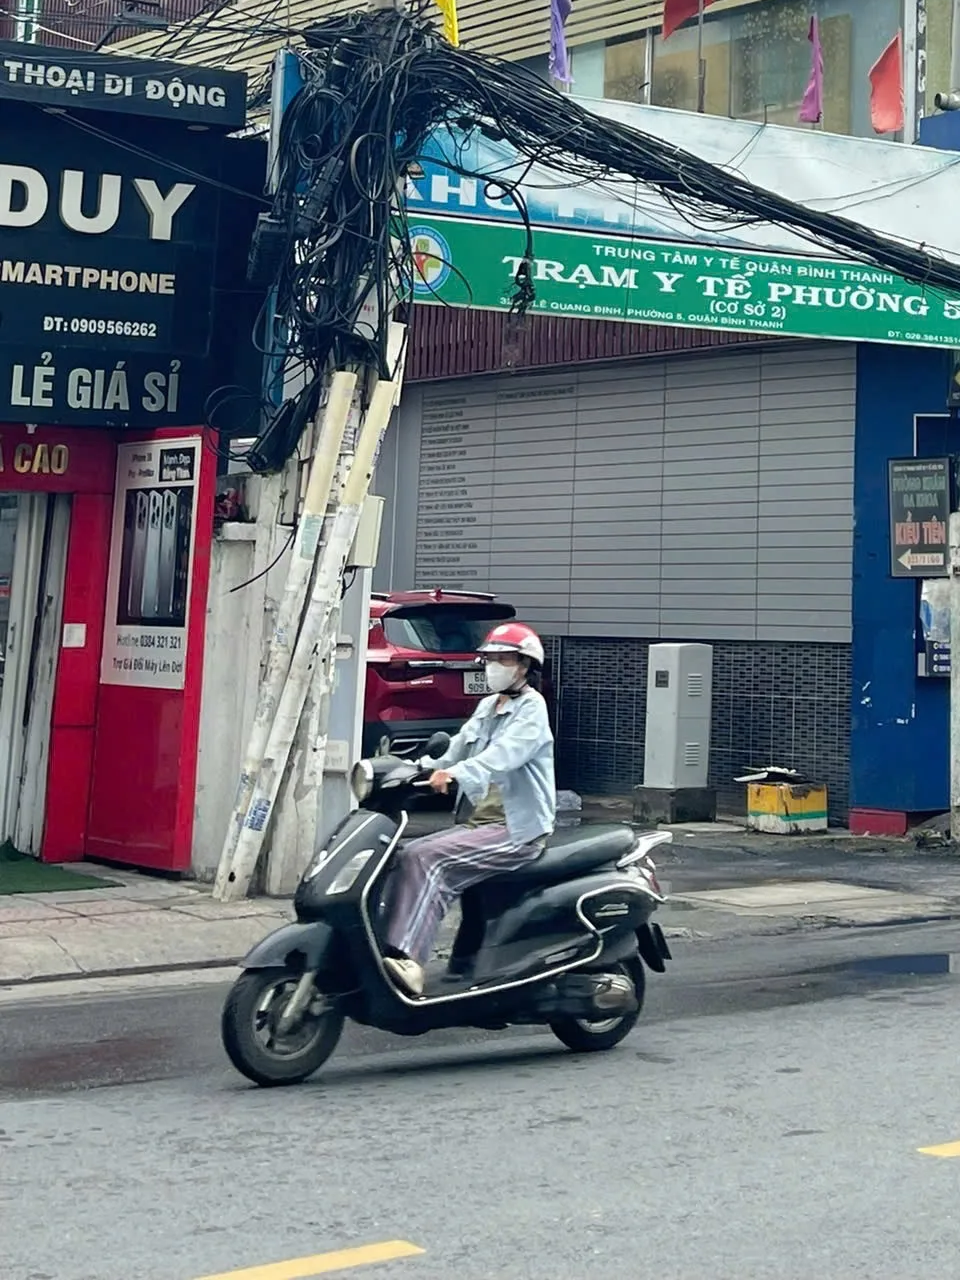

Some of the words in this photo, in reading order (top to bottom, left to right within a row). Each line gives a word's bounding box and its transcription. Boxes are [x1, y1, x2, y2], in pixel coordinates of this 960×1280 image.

[4, 60, 95, 95] THOẠI
[104, 74, 133, 97] DI
[145, 77, 226, 108] ĐỘNG
[0, 164, 196, 241] DUY
[0, 260, 175, 294] MARTPHONE
[592, 245, 655, 261] TRUNG
[661, 251, 697, 265] TÂM
[703, 256, 714, 267] Y
[719, 256, 741, 270] TẾ
[745, 260, 792, 276] QUẬN
[797, 266, 836, 279] BÌNH
[502, 256, 639, 289] TRẠM
[653, 271, 684, 293] Y
[696, 271, 754, 300] TẾ
[767, 281, 930, 316] PHƯỜNG
[551, 302, 591, 313] QUANG
[710, 299, 740, 315] (CƠ
[743, 300, 766, 317] SỞ
[771, 306, 786, 320] 2)
[10, 351, 56, 407] LẺ
[67, 361, 130, 411] GIÁ
[142, 359, 182, 413] SỈ
[14, 443, 69, 474] CAO
